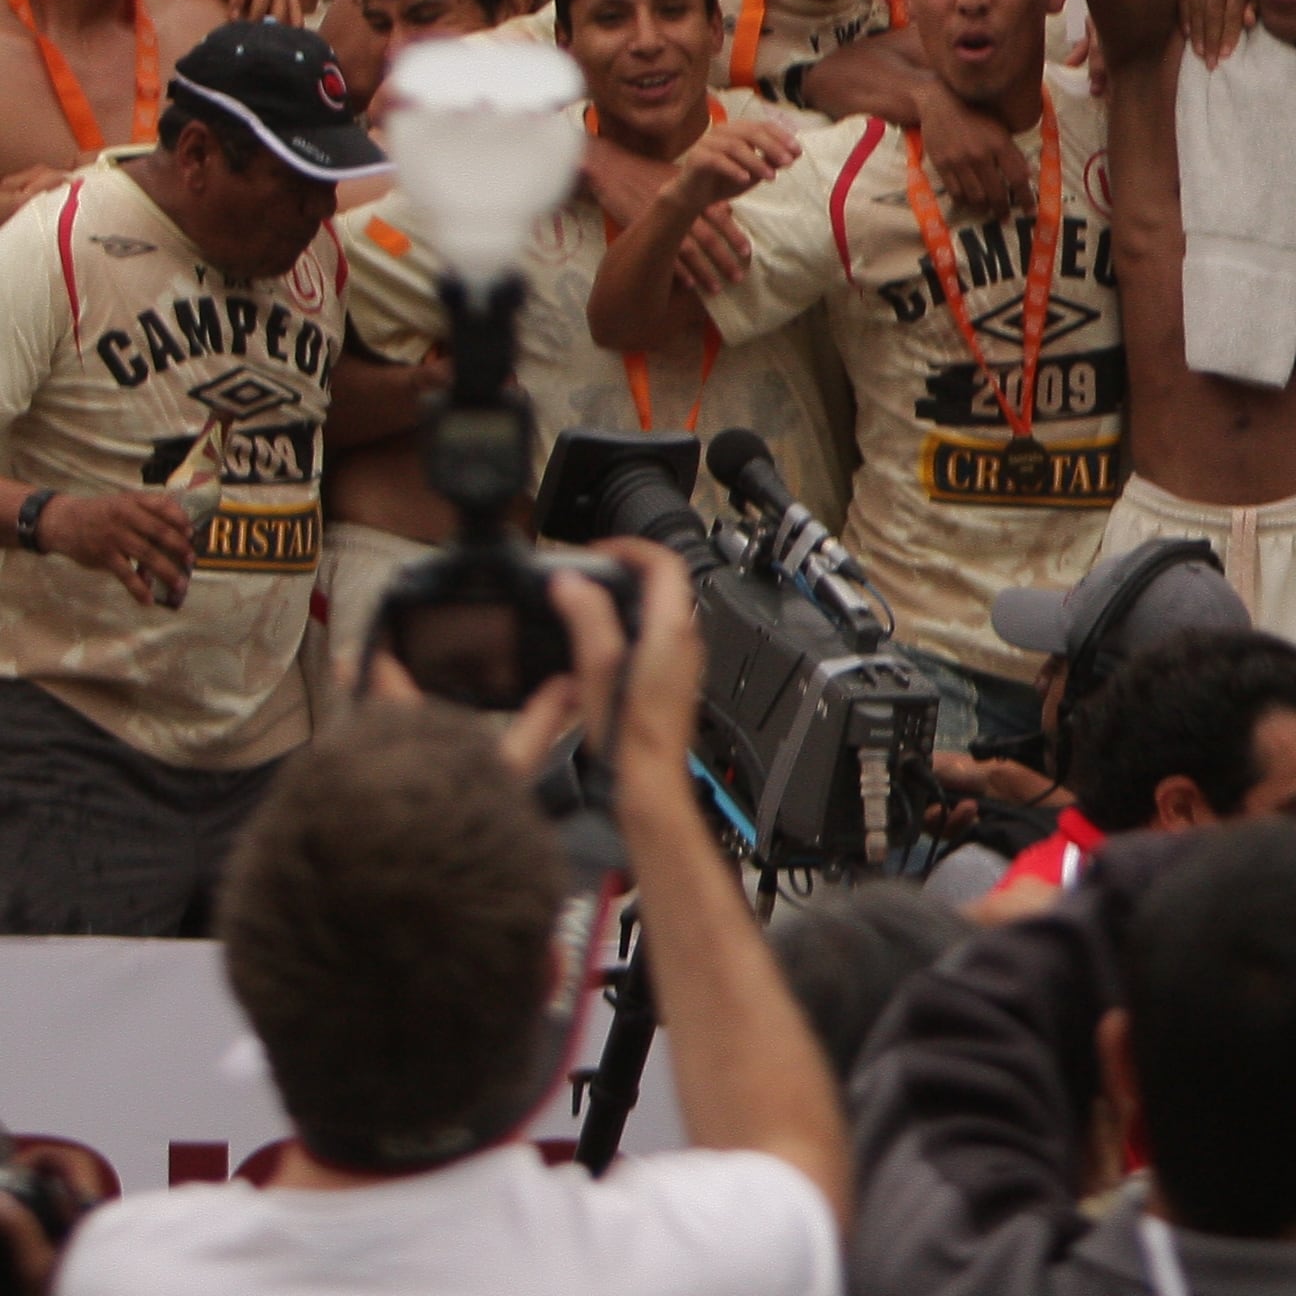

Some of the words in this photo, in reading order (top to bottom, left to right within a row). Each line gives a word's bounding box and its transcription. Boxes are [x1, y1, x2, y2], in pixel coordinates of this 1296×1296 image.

[970, 362, 1098, 417] 2009
[946, 450, 1116, 494] CRTAL
[205, 515, 315, 559] RISTAL
